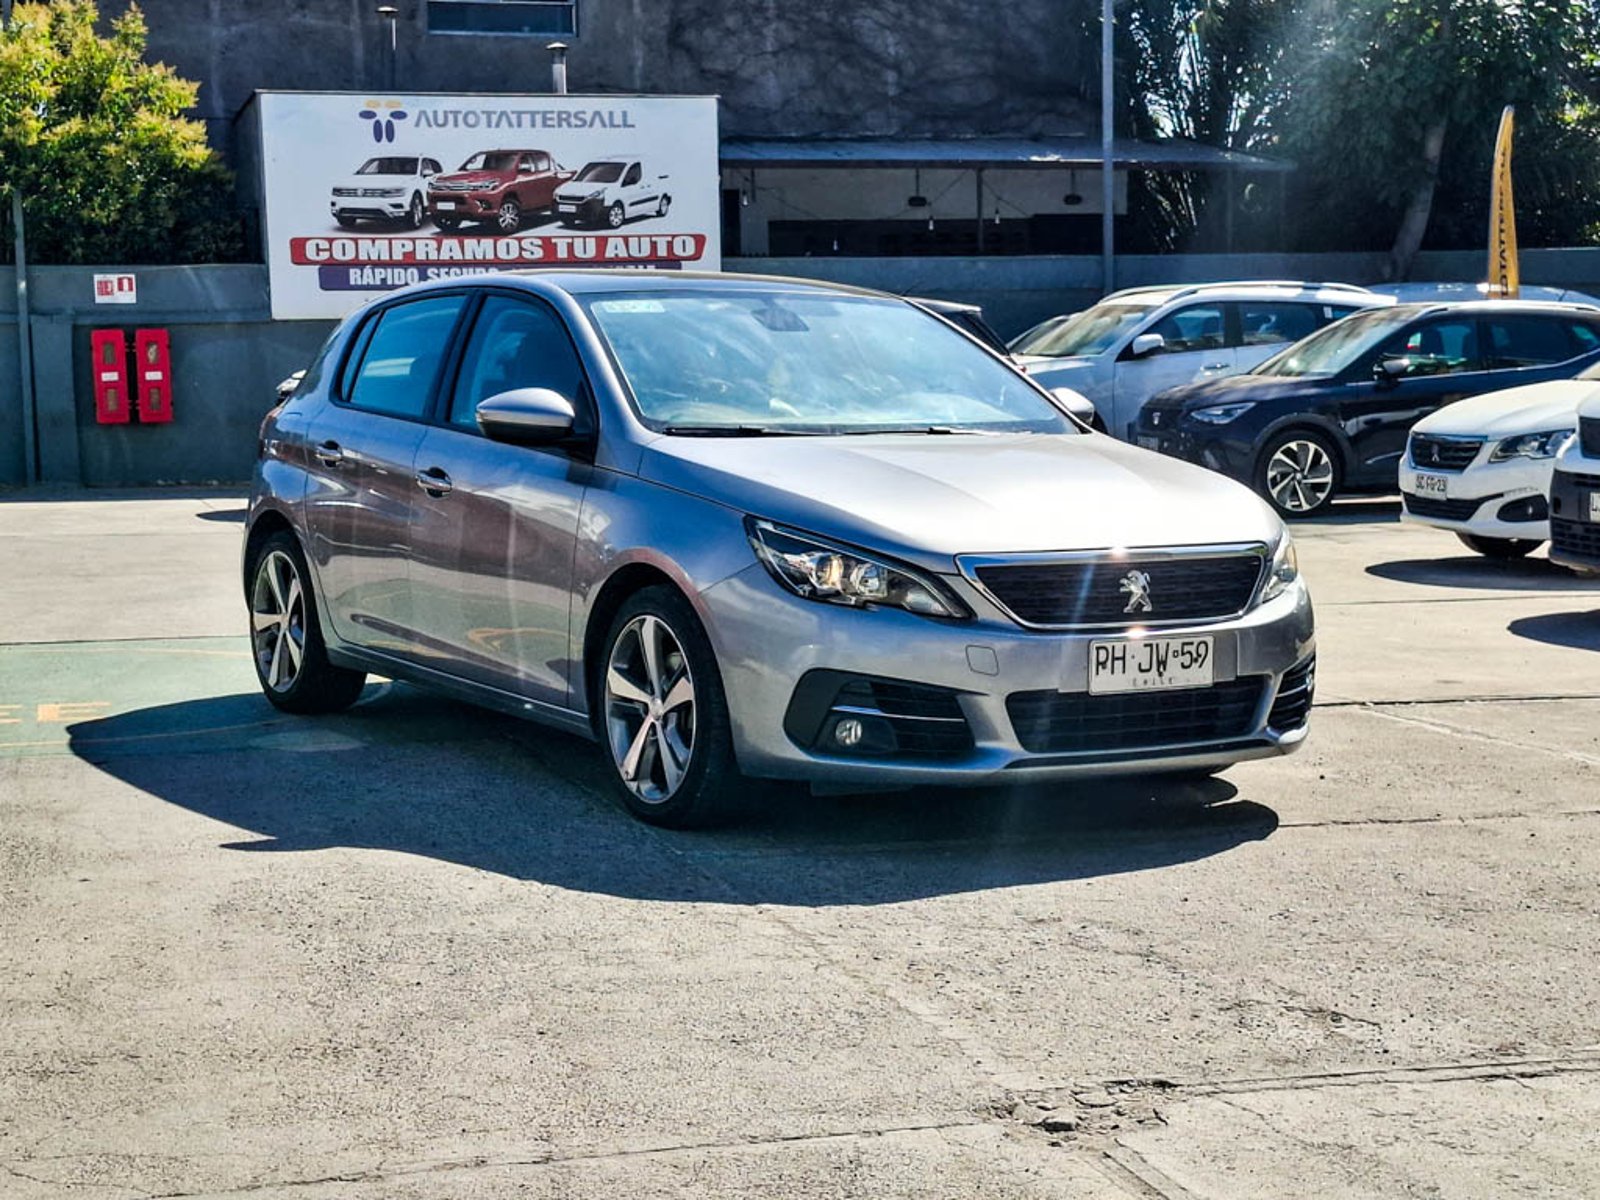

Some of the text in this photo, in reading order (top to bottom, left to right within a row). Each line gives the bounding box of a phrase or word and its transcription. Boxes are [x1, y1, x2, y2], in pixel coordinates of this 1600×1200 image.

[414, 110, 636, 129] AUTOTATTERSALL
[305, 235, 696, 261] COMPRAMOS TU AUTO
